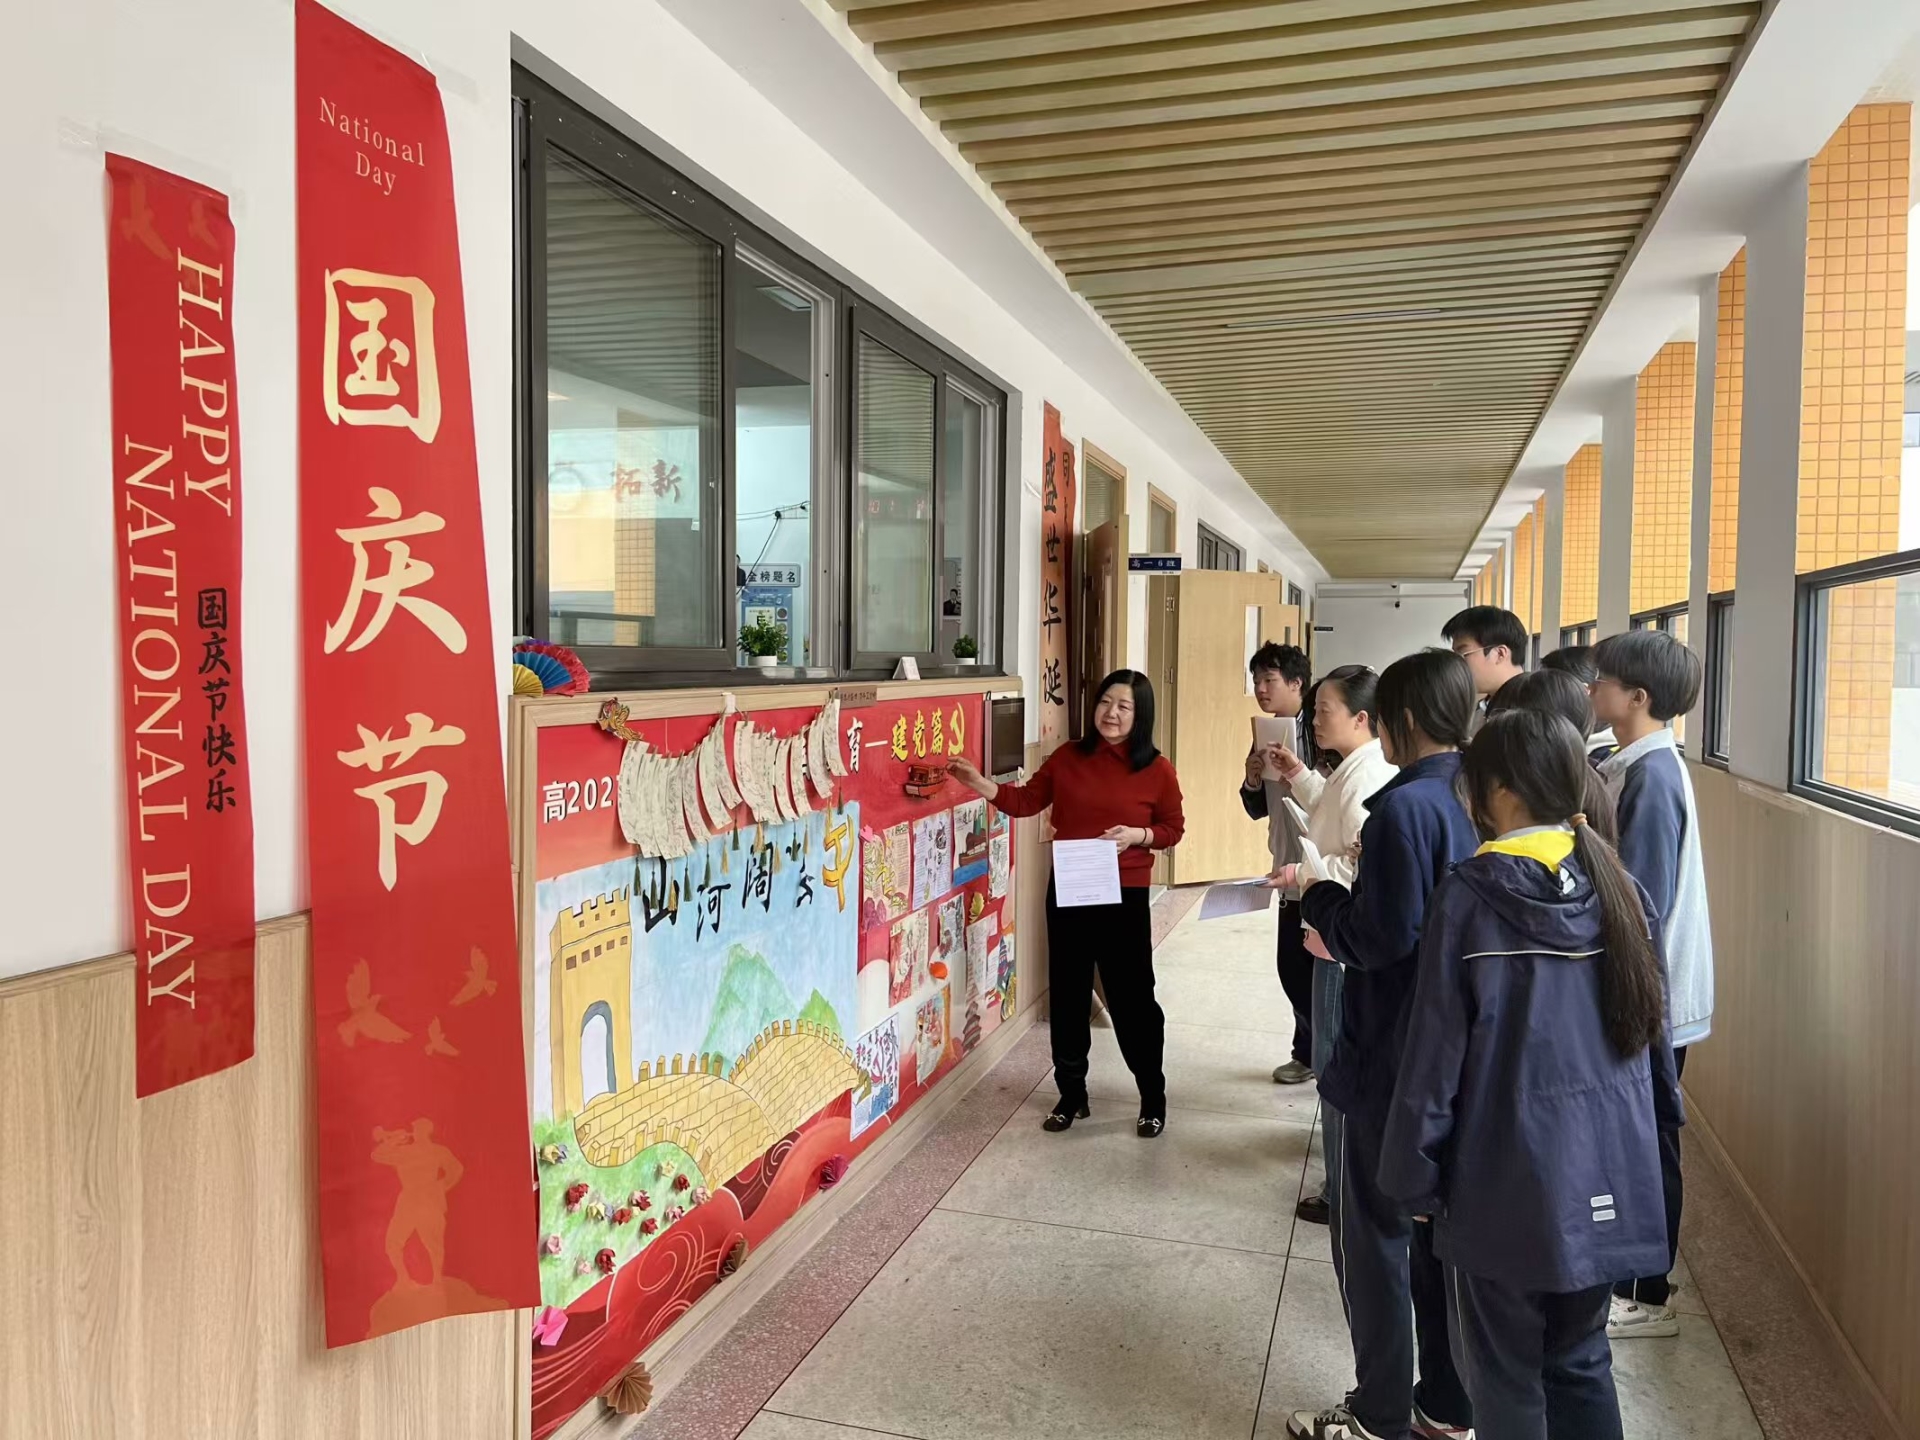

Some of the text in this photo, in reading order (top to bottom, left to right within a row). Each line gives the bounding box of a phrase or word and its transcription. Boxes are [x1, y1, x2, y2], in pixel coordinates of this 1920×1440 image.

[318, 97, 426, 167] National
[355, 151, 397, 196] Day
[176, 246, 233, 517] HAPPY
[322, 267, 469, 892] 国庆节
[747, 570, 797, 584] 金榜题名
[1042, 447, 1065, 706] 盛世华诞
[124, 434, 196, 1010] NATIONAL DAY
[197, 587, 237, 814] 国庆节快乐
[543, 775, 621, 825] 高202
